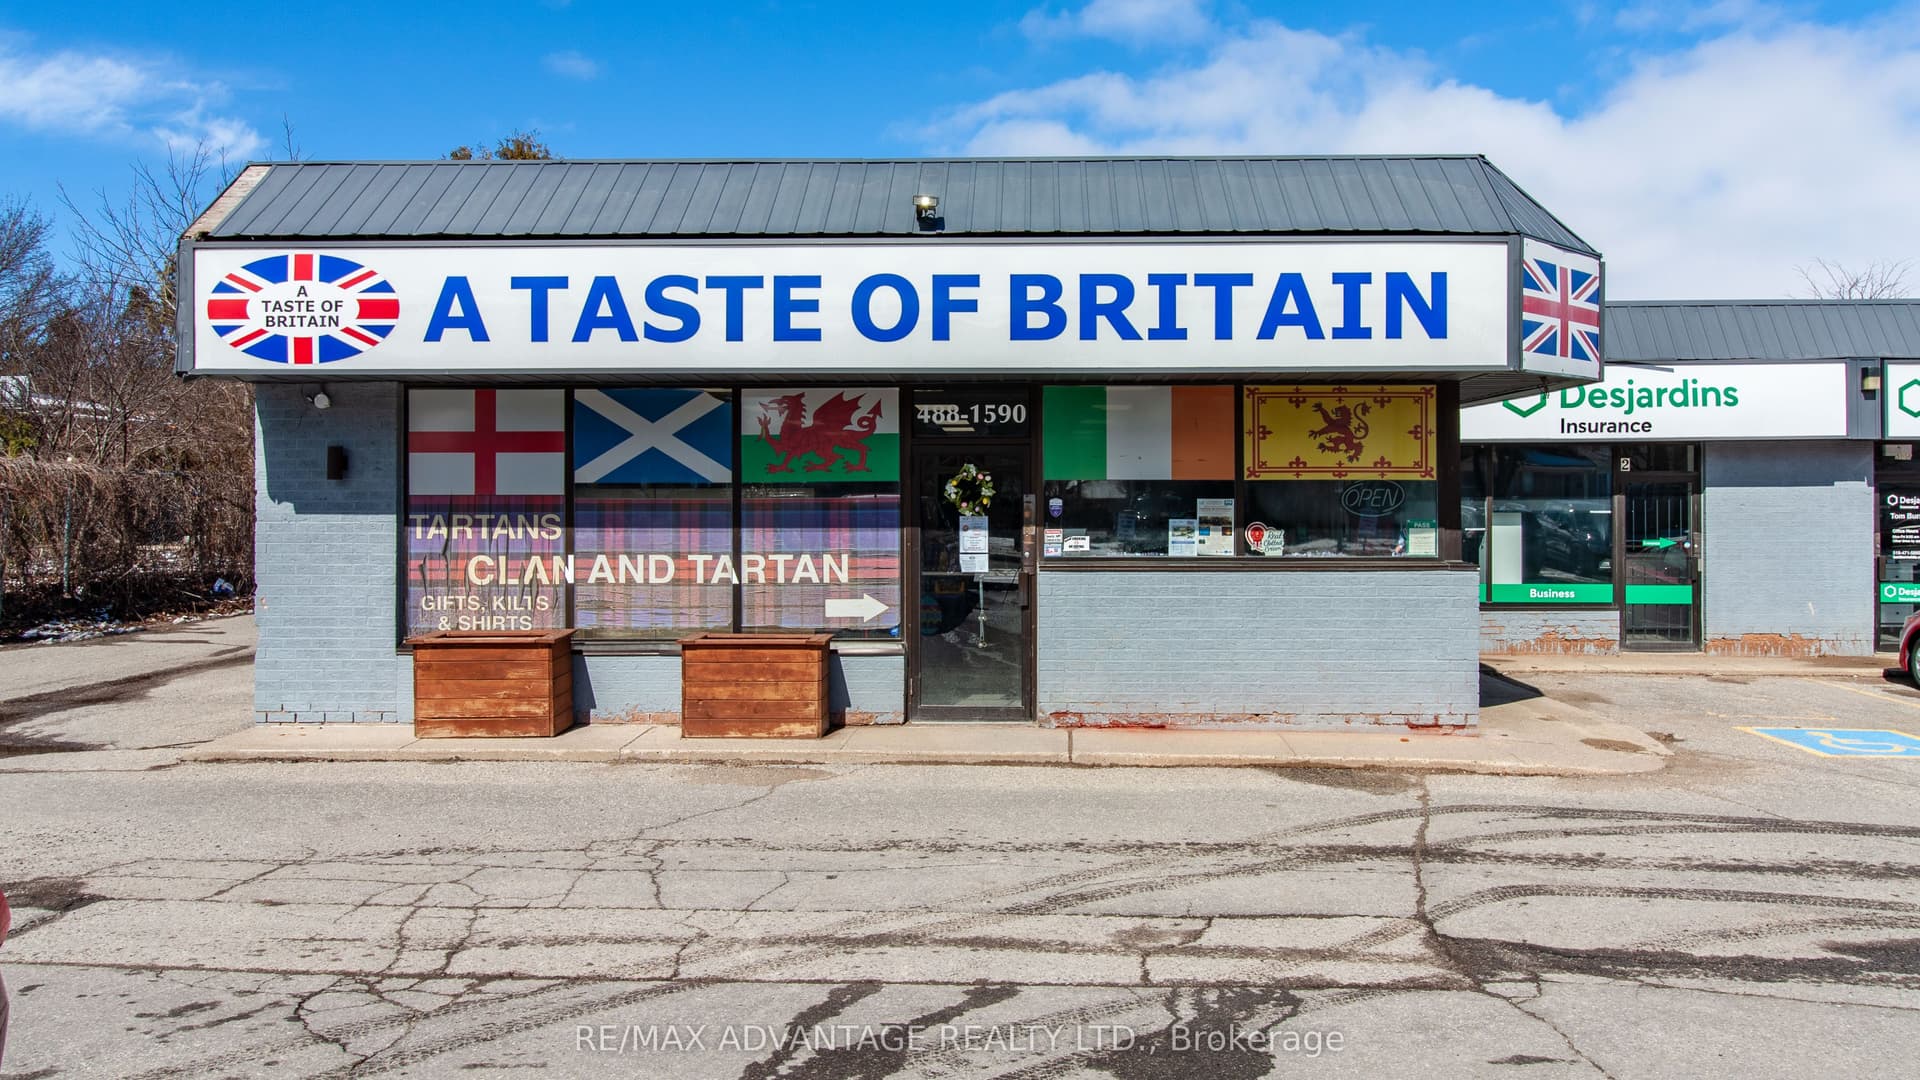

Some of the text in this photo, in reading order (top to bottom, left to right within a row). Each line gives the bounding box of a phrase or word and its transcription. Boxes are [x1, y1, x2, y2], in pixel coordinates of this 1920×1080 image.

[297, 285, 308, 298] A
[261, 300, 344, 313] TASTE OF
[424, 271, 1448, 344] A TASTE OF BRITAIN
[265, 315, 339, 328] BRITAIN
[1560, 378, 1740, 416] Desjardins
[916, 403, 1027, 424] 488-1590
[1560, 418, 1653, 434] Insurance
[1621, 458, 1630, 471] 2
[1345, 488, 1399, 507] OPEN
[408, 513, 563, 541] TARTANS
[467, 553, 849, 586] CLAN AND TARTAN
[1529, 588, 1576, 599] Business
[421, 595, 550, 614] GIFTS, KILTS
[438, 615, 533, 631] & SHIRTS
